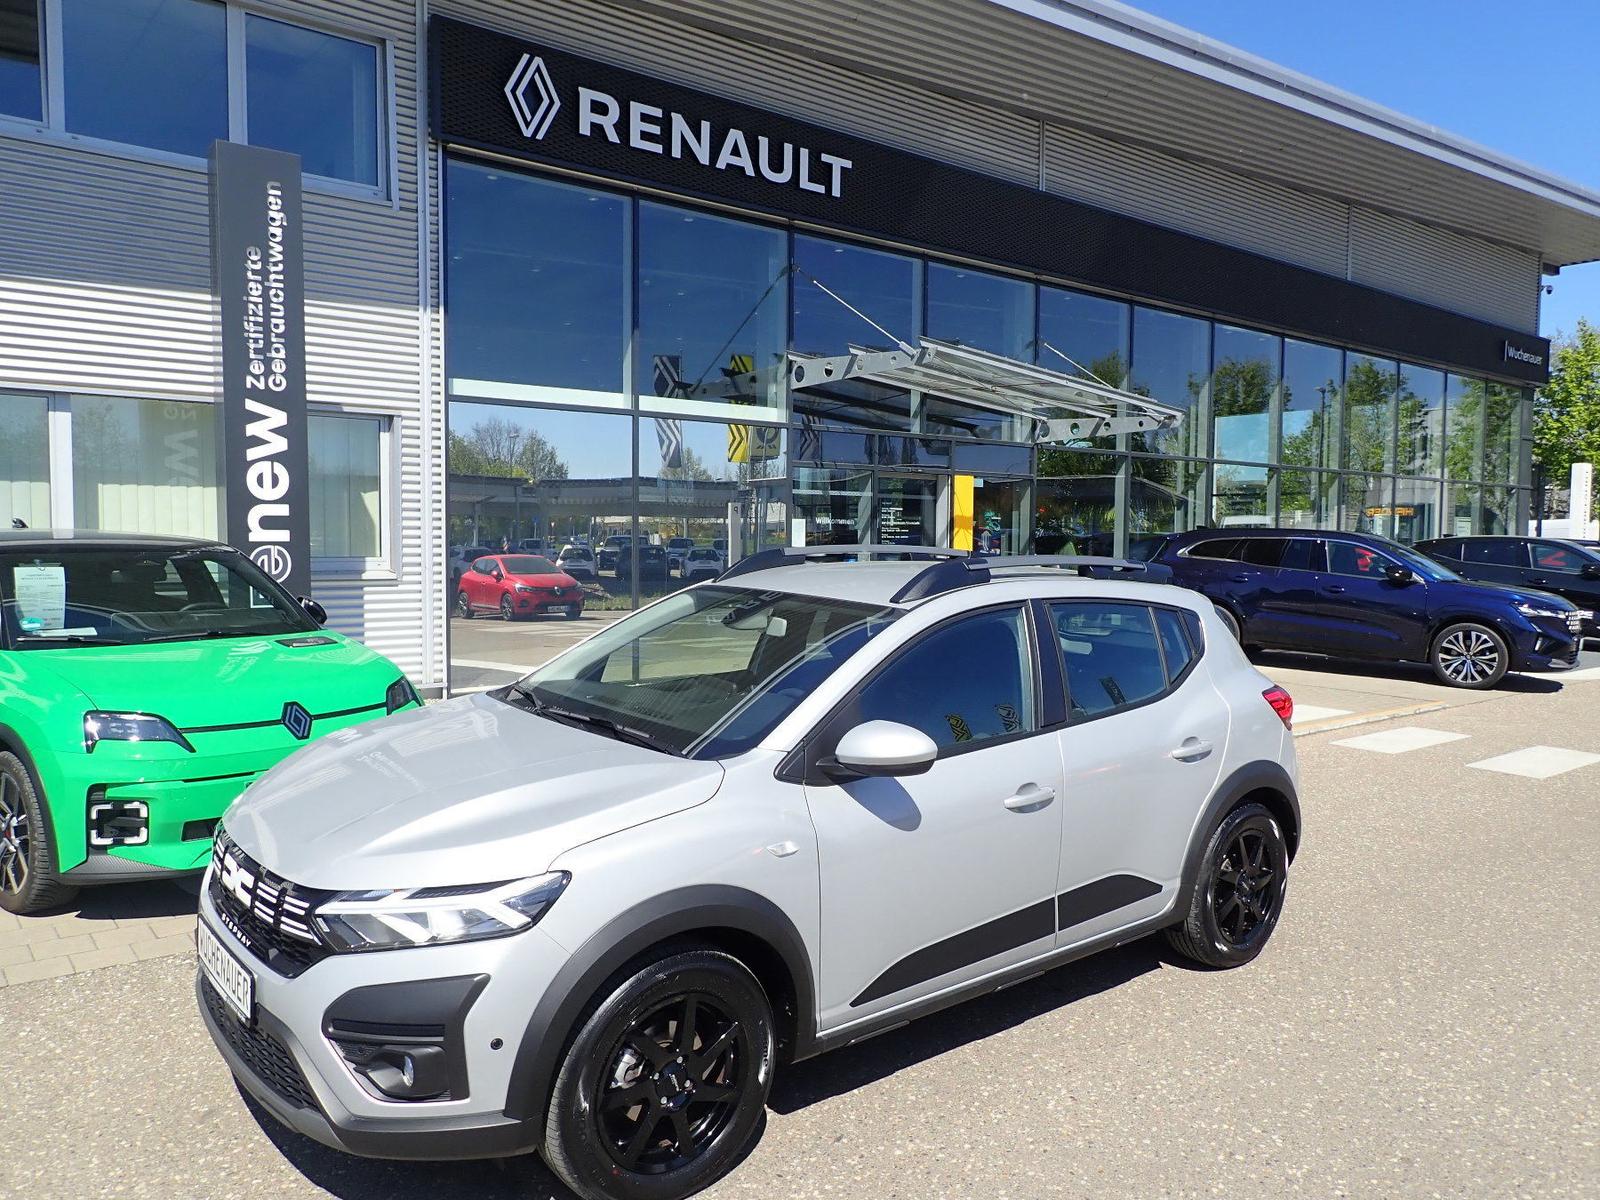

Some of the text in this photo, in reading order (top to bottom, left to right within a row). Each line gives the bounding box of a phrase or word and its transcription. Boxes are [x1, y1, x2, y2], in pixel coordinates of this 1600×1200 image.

[578, 86, 853, 198] RENAULT
[244, 246, 264, 390] Zertifizierte
[266, 181, 288, 392] Gebrauchtwagen
[221, 912, 252, 948] STEPWAY
